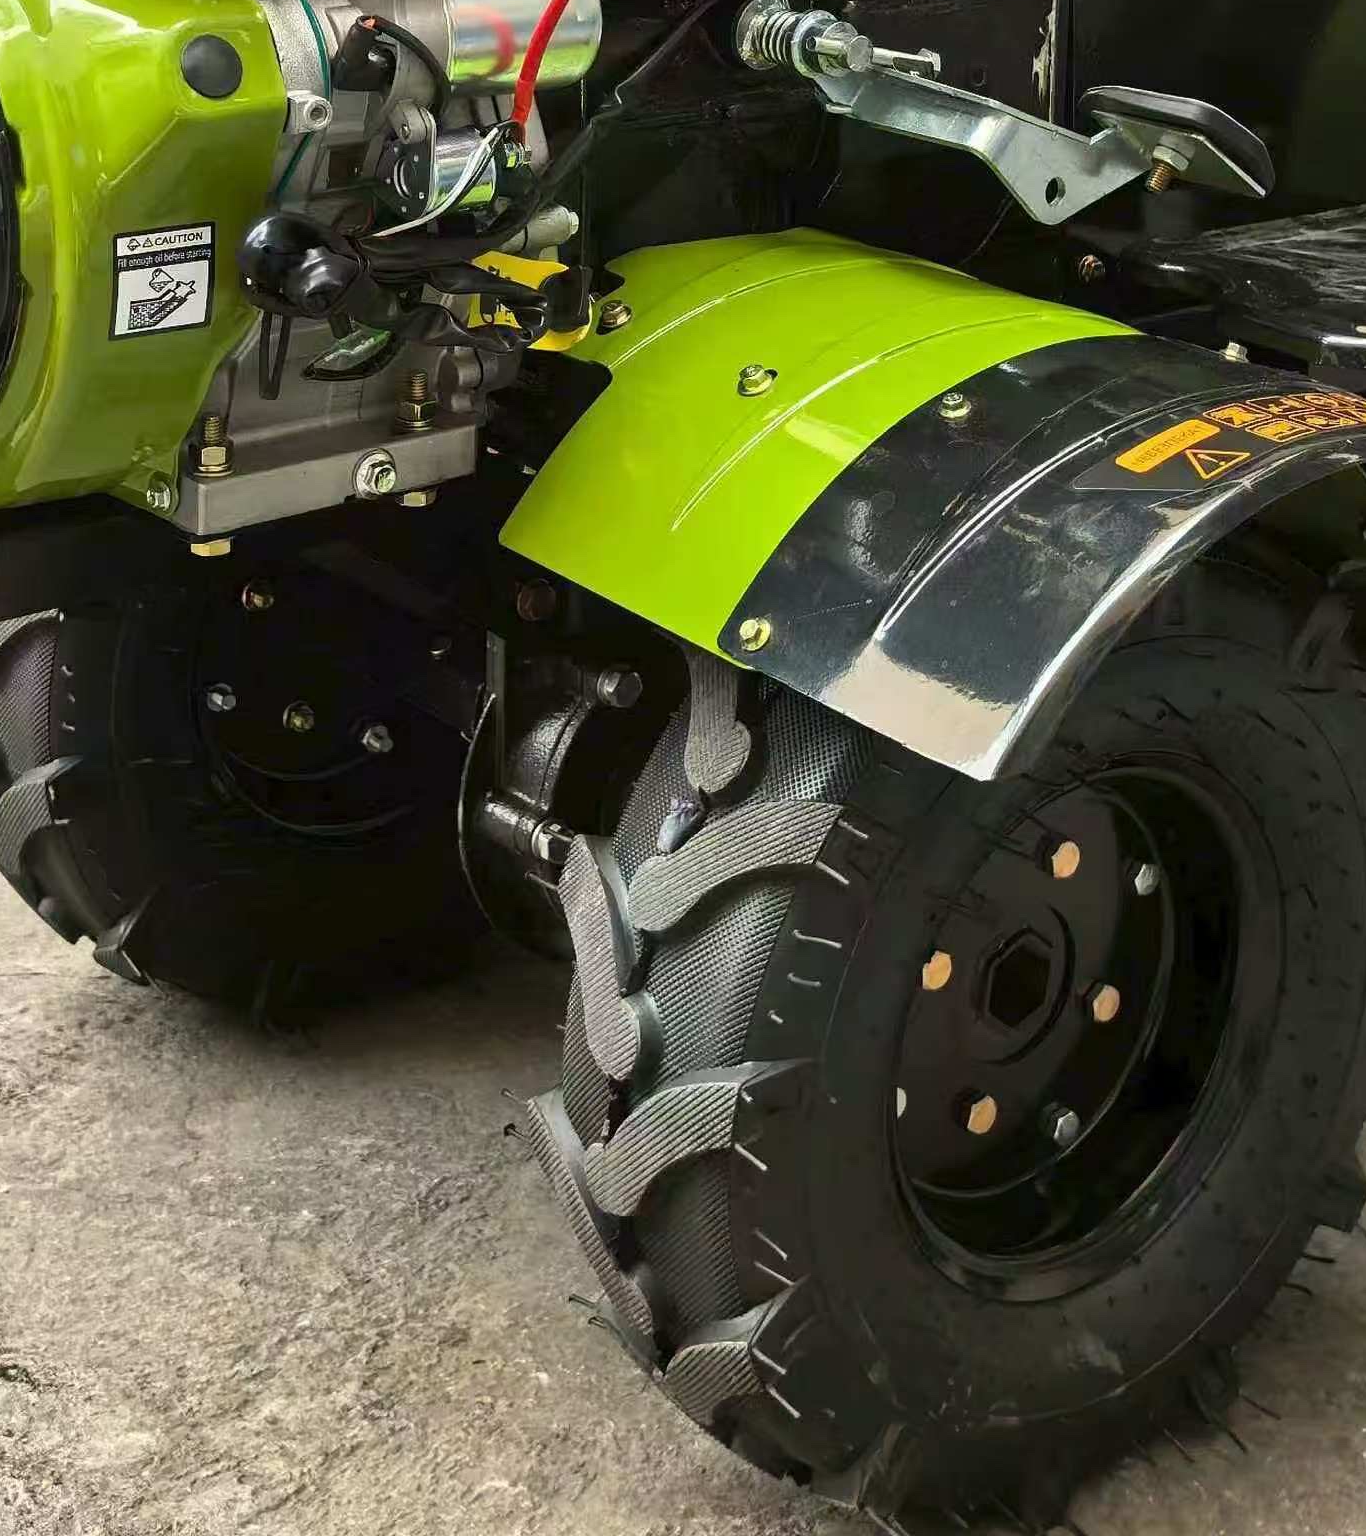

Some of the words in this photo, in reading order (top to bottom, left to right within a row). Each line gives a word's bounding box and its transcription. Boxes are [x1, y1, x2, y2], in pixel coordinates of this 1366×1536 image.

[154, 231, 203, 246] CAUTION
[128, 256, 153, 267] enough
[164, 250, 185, 262] before
